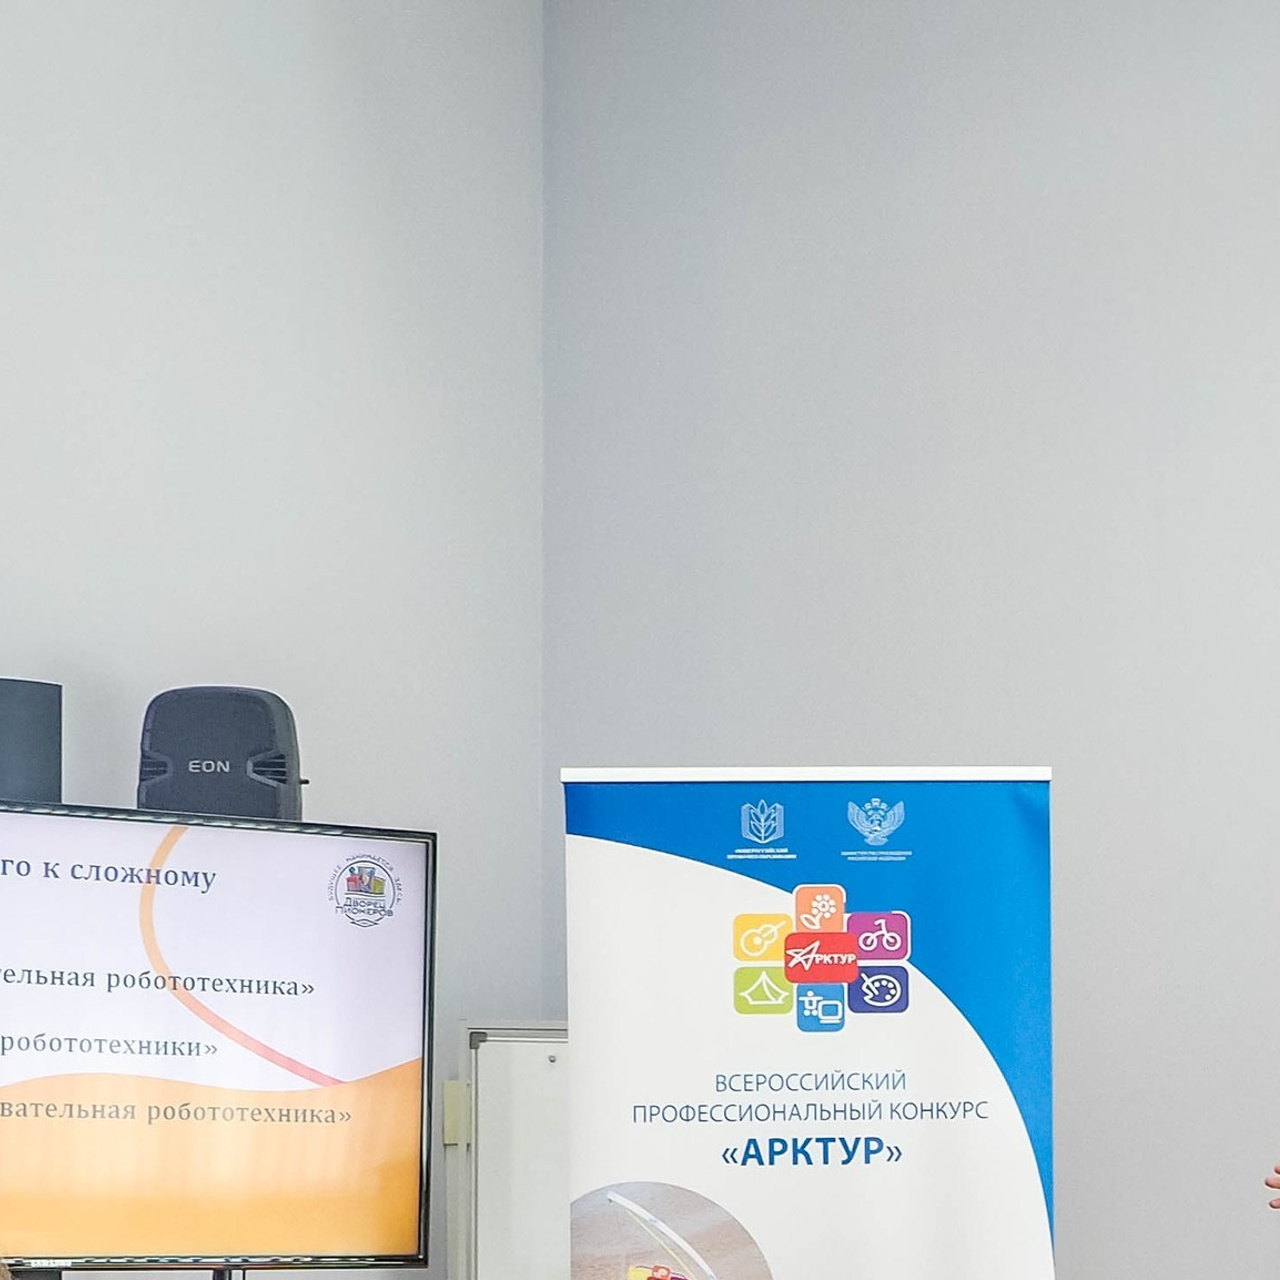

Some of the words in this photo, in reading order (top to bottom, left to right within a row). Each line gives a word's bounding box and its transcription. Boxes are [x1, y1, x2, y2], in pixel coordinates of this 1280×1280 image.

[189, 760, 230, 773] EON
[43, 861, 60, 879] к
[70, 864, 217, 894] сложному
[0, 968, 96, 987] ельная
[107, 971, 315, 996] робототехника»
[1, 1032, 218, 1057] робототехники»
[715, 1069, 906, 1093] ВСЕРОССИЙСКИЙ
[0, 1102, 136, 1120] вательная
[148, 1102, 352, 1125] робототехника»
[633, 1099, 883, 1123] ПРОФЕССИОНАЛЬНЫЙ
[890, 1101, 989, 1121] КОНКУРС
[722, 1137, 902, 1166] «АРКТУР»
